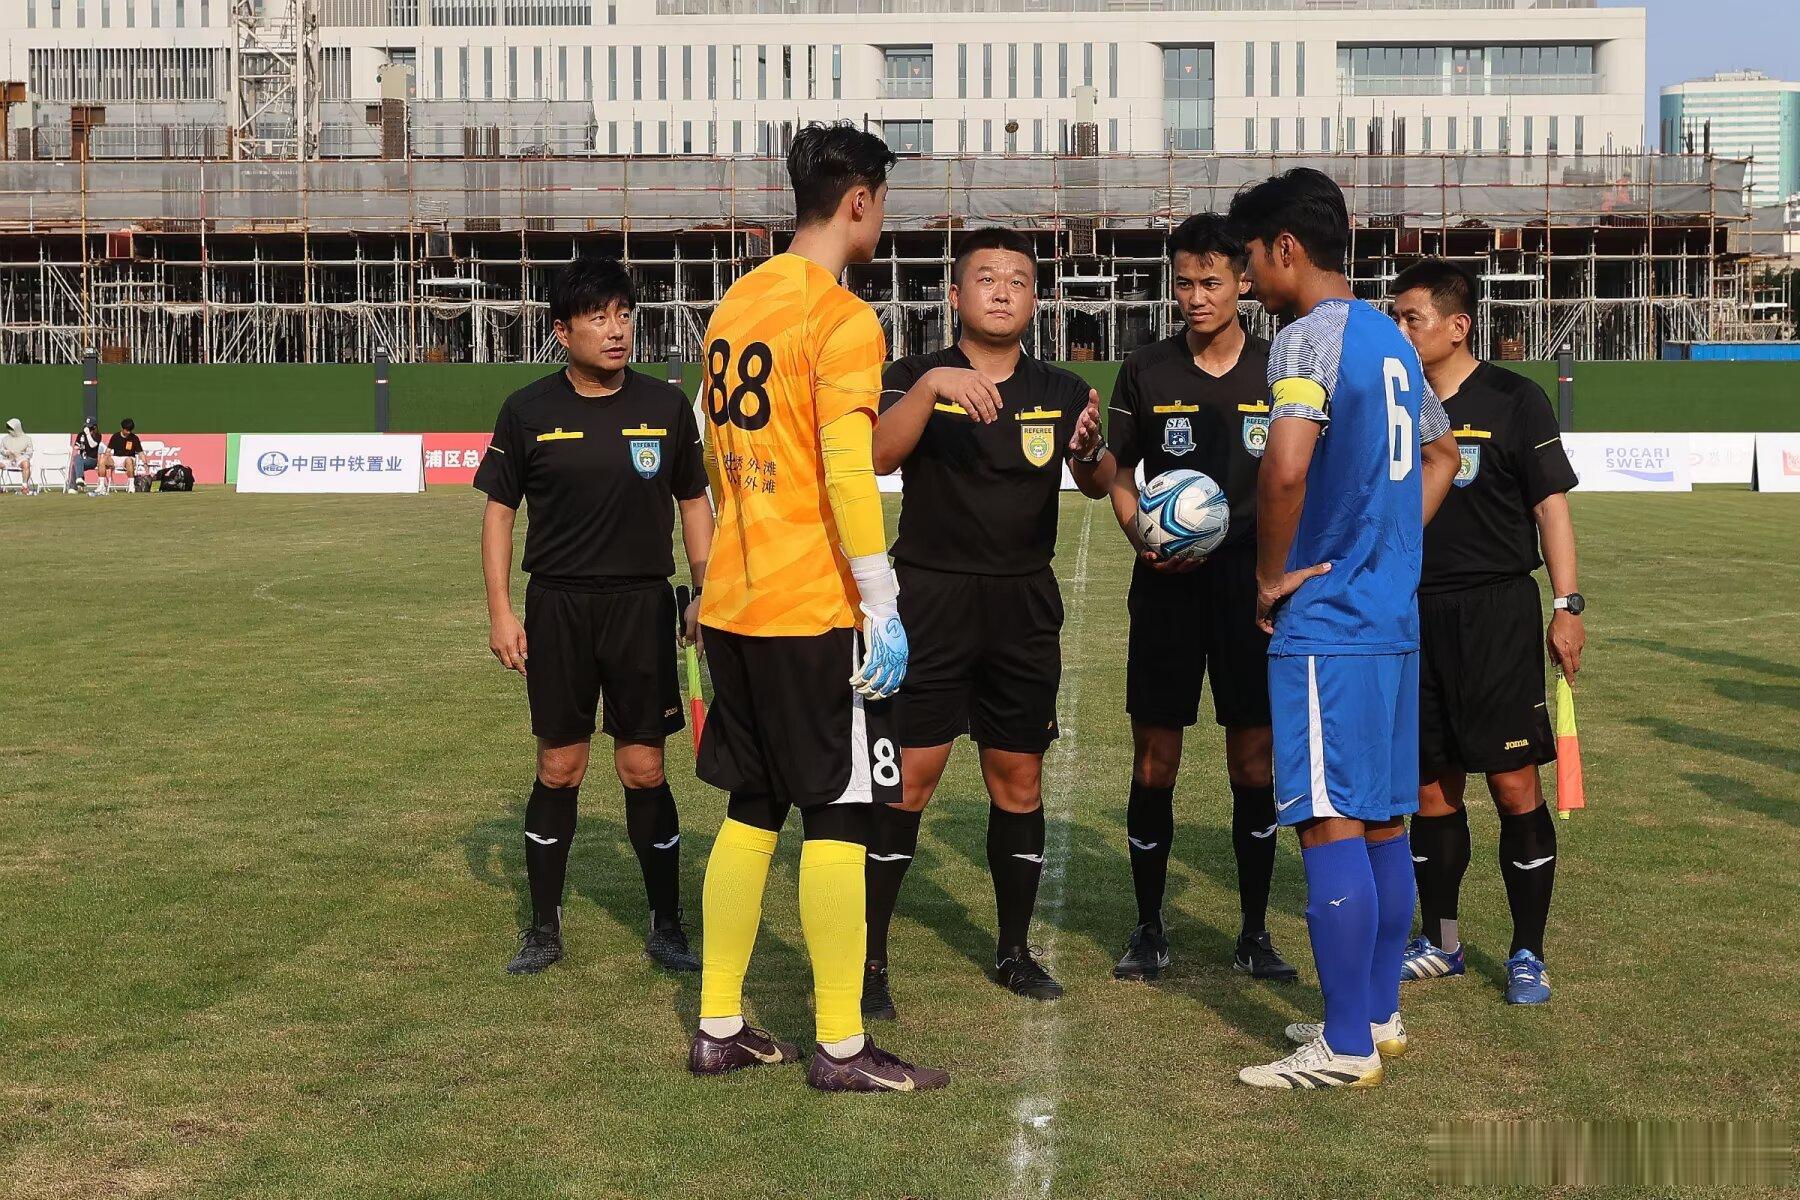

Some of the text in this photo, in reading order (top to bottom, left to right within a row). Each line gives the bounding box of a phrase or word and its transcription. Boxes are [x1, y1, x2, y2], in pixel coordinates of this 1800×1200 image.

[708, 338, 773, 431] 88
[1383, 357, 1412, 481] 6
[424, 449, 481, 468] 浦区总
[1605, 447, 1670, 458] POCARI
[291, 455, 402, 472] 中国中铁置业
[1606, 458, 1664, 469] SWEAT
[872, 738, 900, 787] 8
